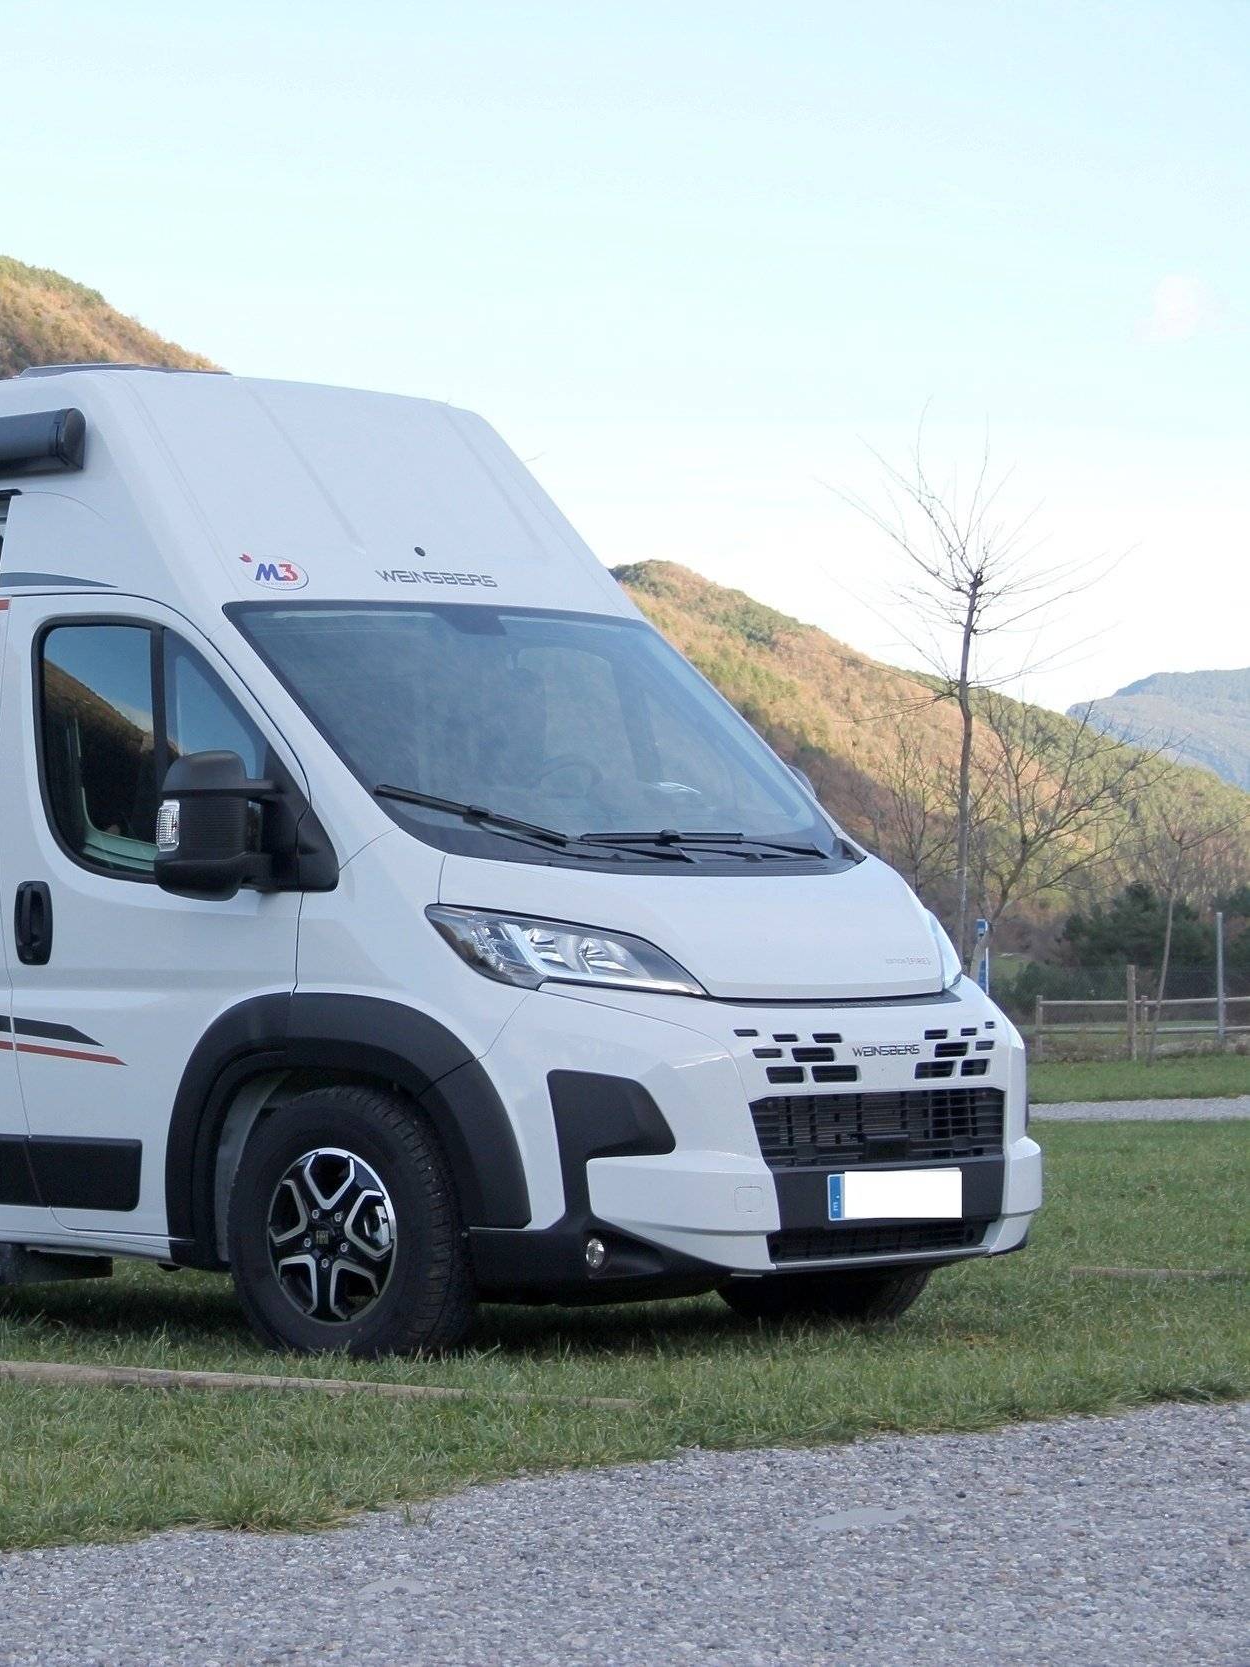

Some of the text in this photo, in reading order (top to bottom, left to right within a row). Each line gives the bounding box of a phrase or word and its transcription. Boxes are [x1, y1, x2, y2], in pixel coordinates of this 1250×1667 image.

[255, 563, 299, 581] M3
[374, 570, 499, 588] WEINSBERG
[852, 1044, 920, 1057] WEINSBERG
